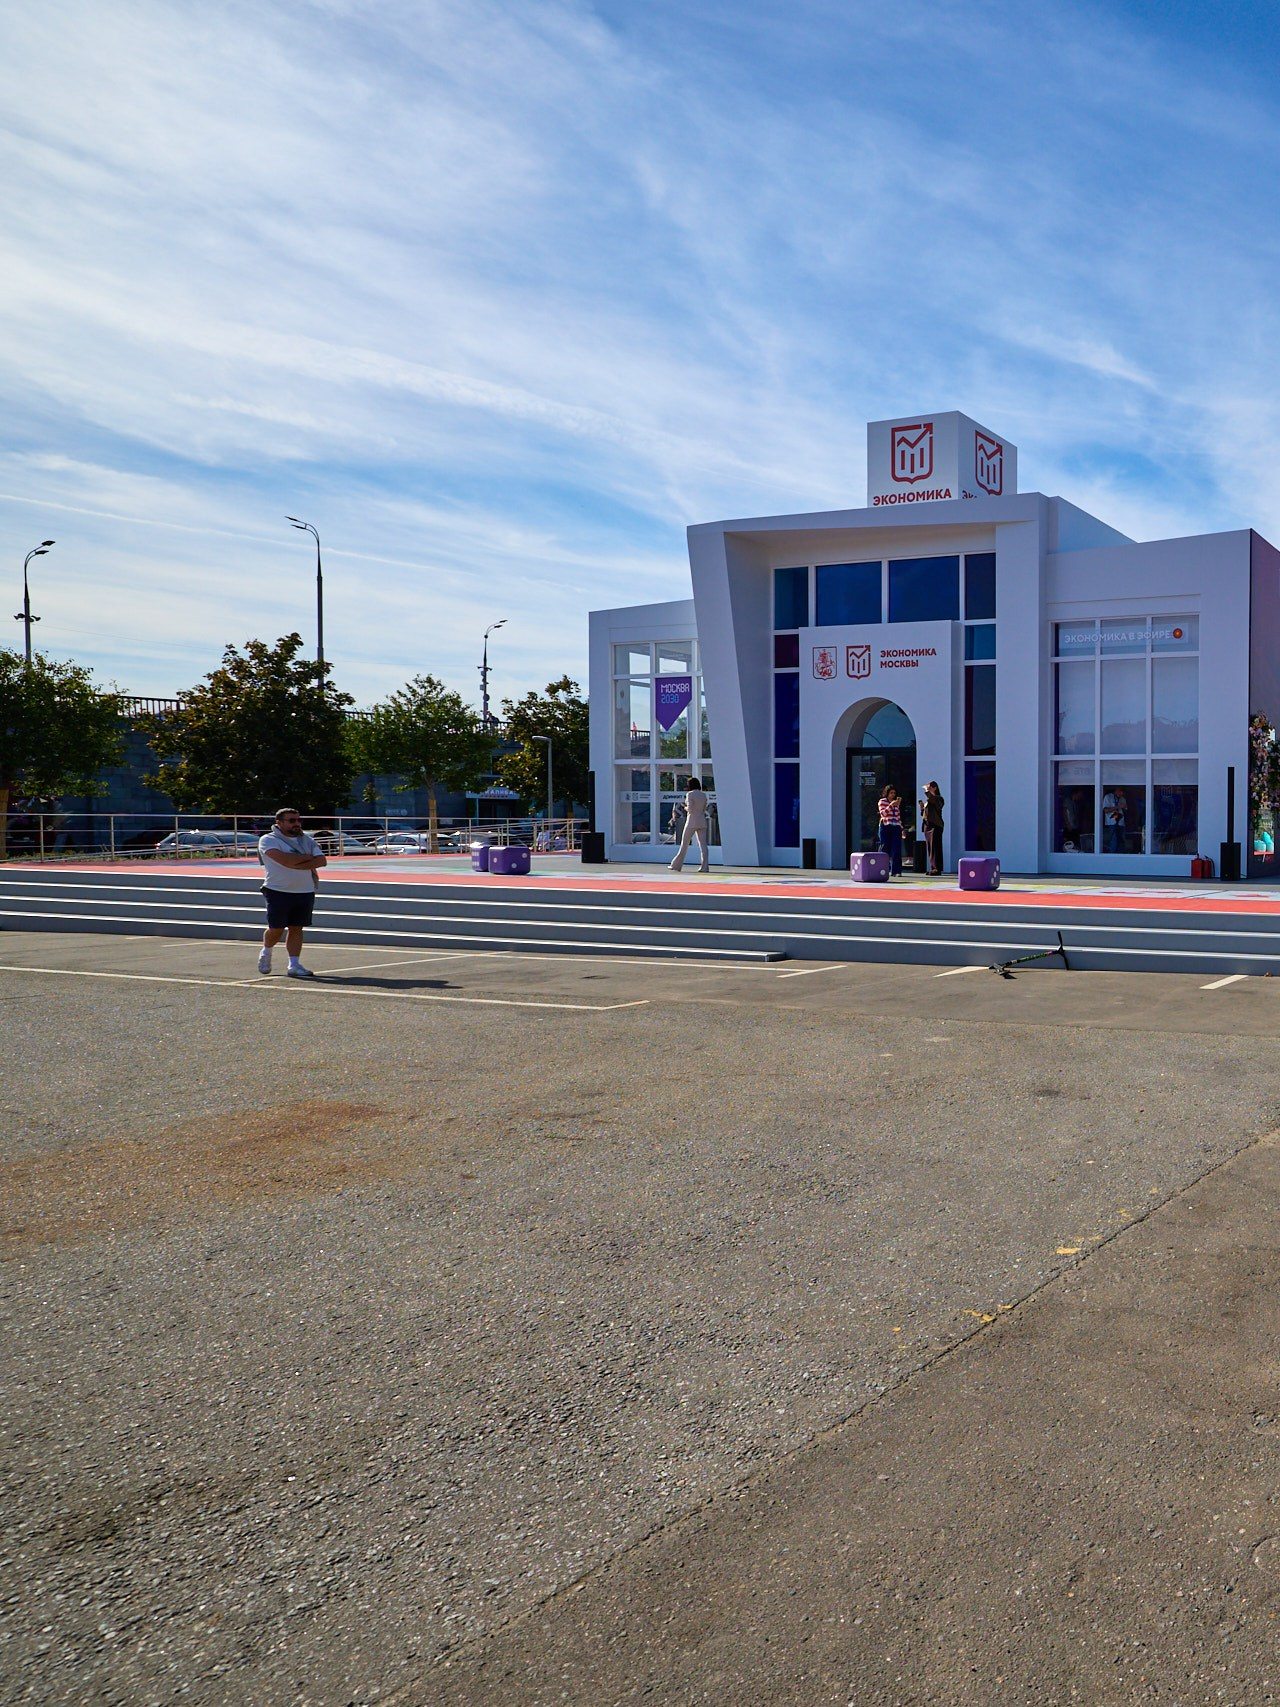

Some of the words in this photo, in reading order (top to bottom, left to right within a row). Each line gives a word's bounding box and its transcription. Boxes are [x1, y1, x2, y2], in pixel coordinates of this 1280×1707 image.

[873, 488, 952, 506] ЭКОНОМИКА
[1064, 632, 1127, 643] ЭКОНОМИКА
[1136, 630, 1171, 640] ЭФИРЕ
[880, 648, 937, 657] ЭКОНОМИКА
[880, 660, 919, 668] МОСКВЫ
[661, 683, 690, 693] МОСКВА
[661, 694, 679, 704] 2030
